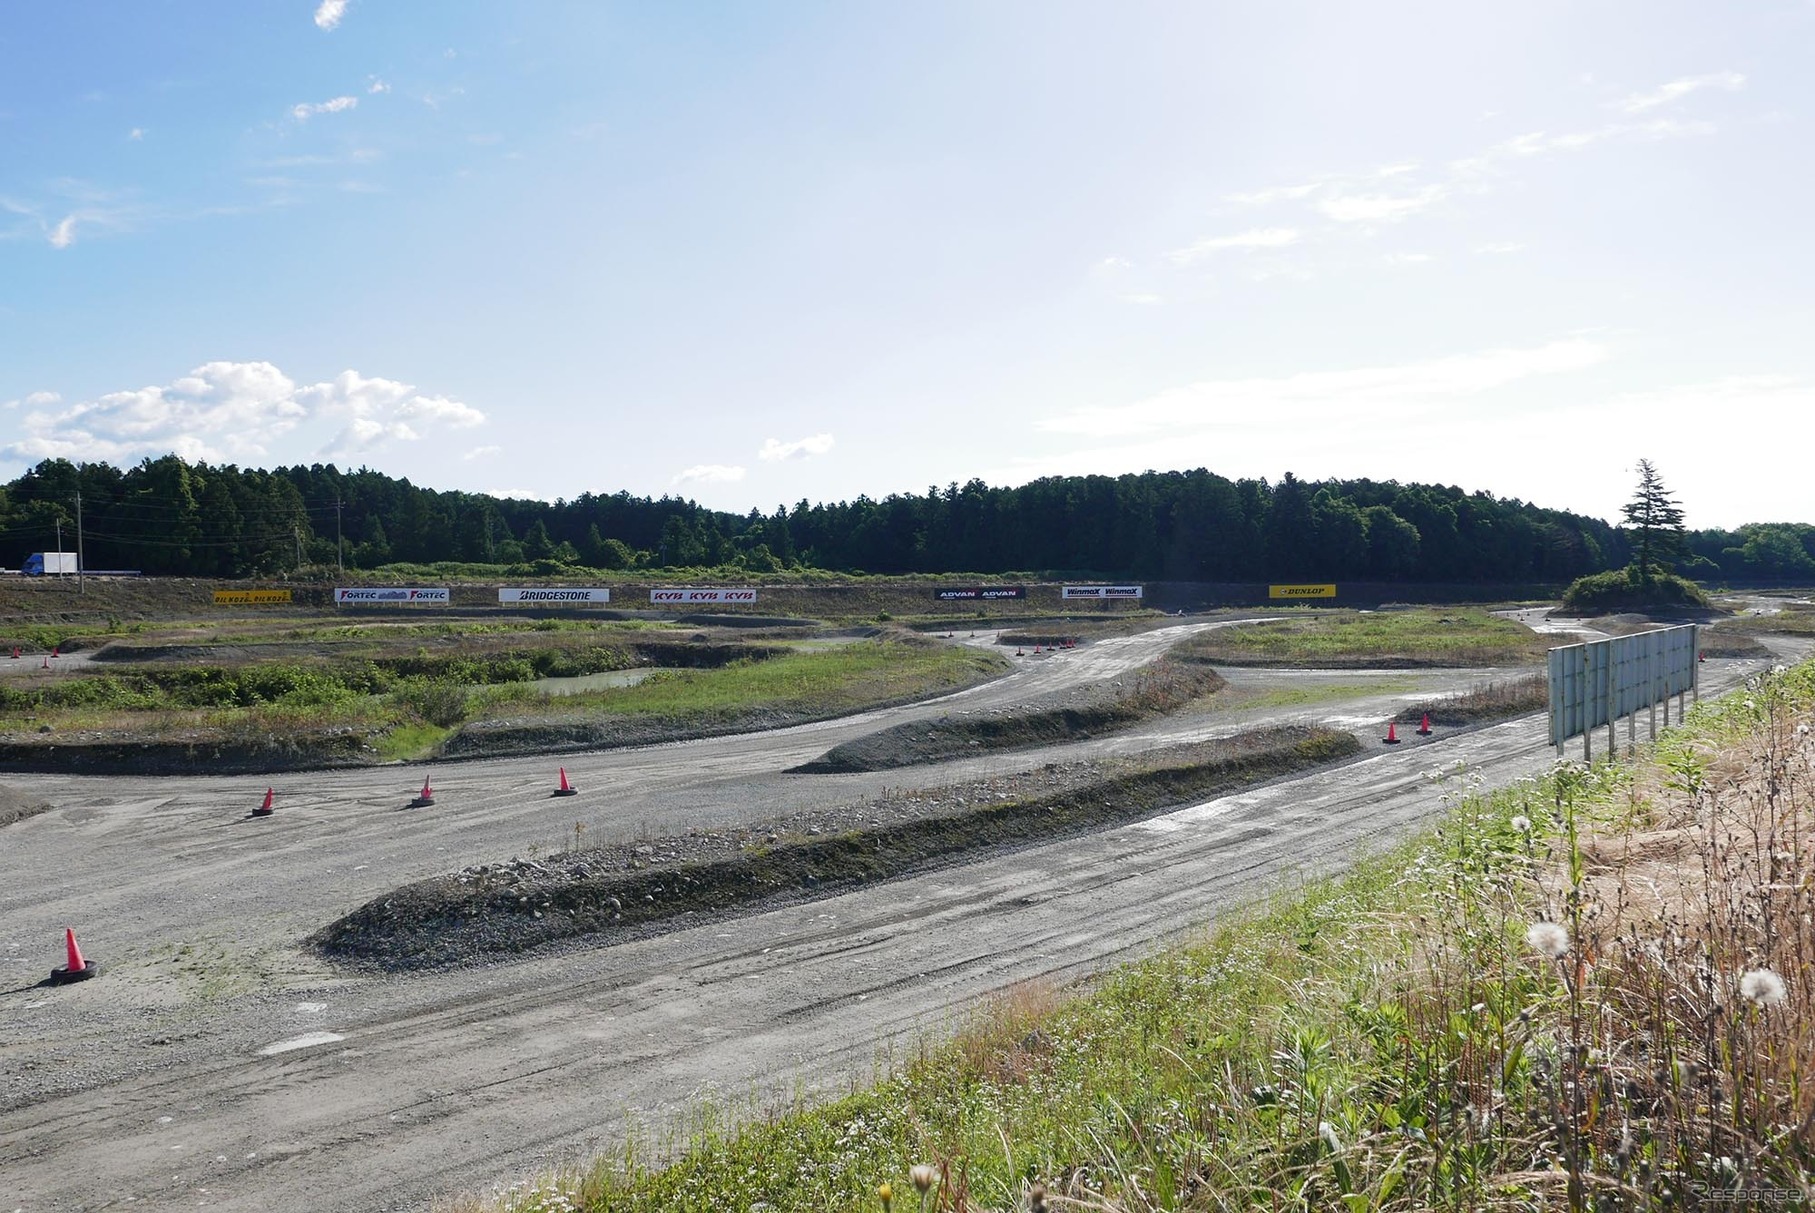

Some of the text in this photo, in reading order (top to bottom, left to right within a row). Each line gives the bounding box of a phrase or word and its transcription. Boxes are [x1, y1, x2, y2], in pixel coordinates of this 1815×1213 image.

[341, 590, 446, 600] FORTEC FORTEC
[519, 591, 591, 600] BRIDGESTONE
[654, 592, 754, 600] KYB KYB KYB
